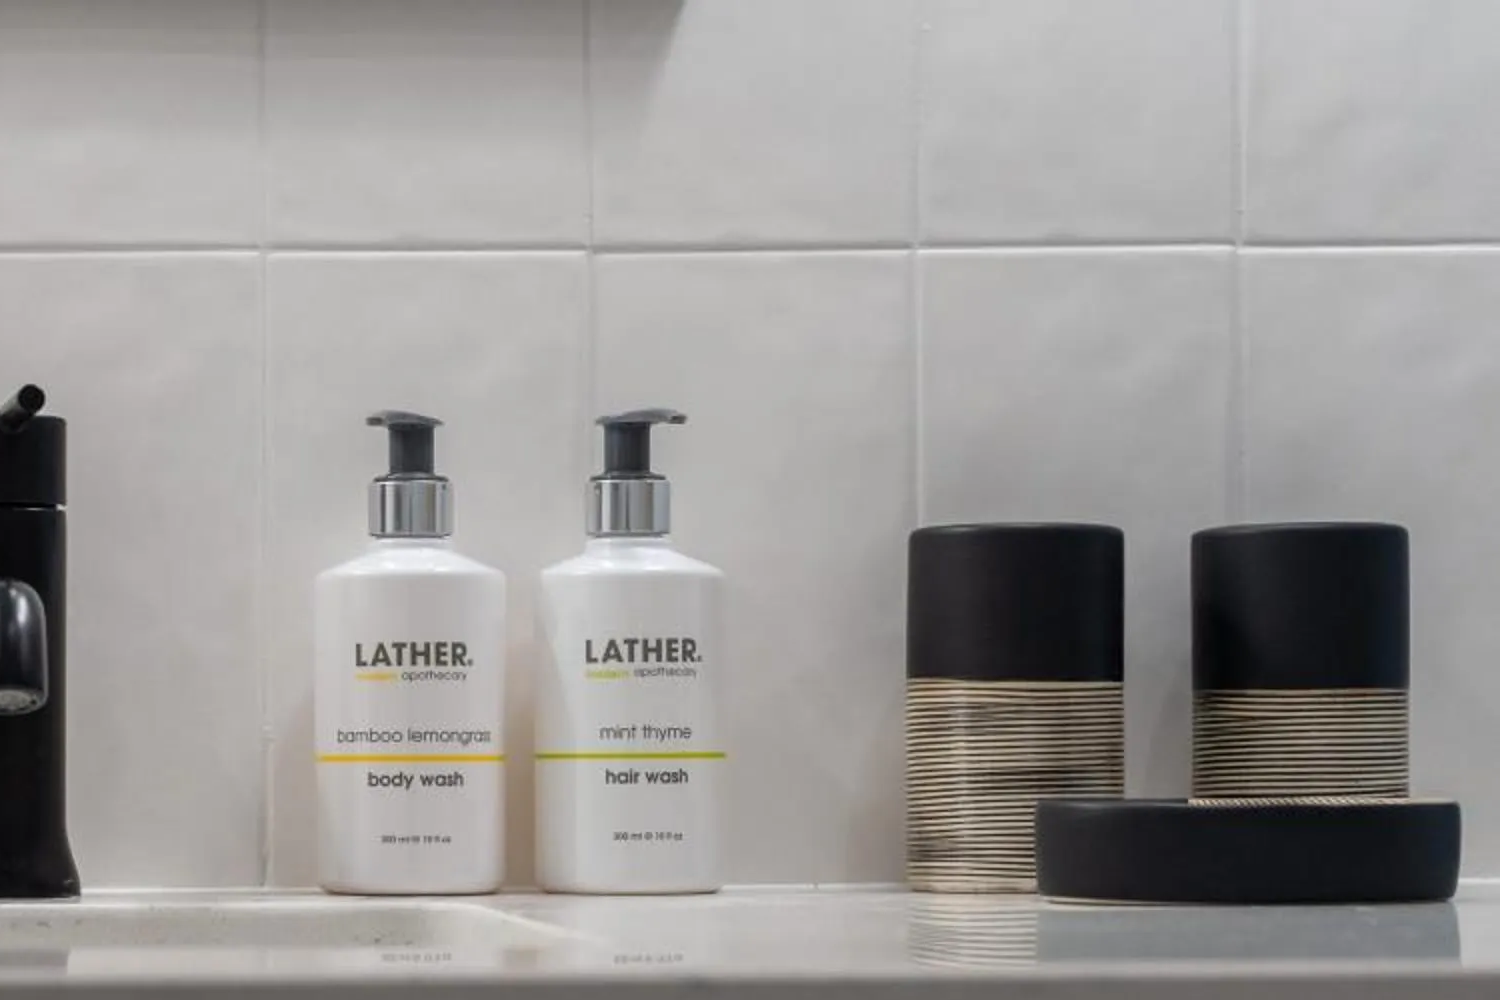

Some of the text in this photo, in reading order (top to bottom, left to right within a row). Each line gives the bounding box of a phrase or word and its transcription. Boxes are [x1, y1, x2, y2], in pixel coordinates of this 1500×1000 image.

[337, 728, 402, 744] bamboo
[600, 723, 692, 742] mint thyme
[368, 772, 464, 789] body wash
[606, 768, 689, 785] hair wash
